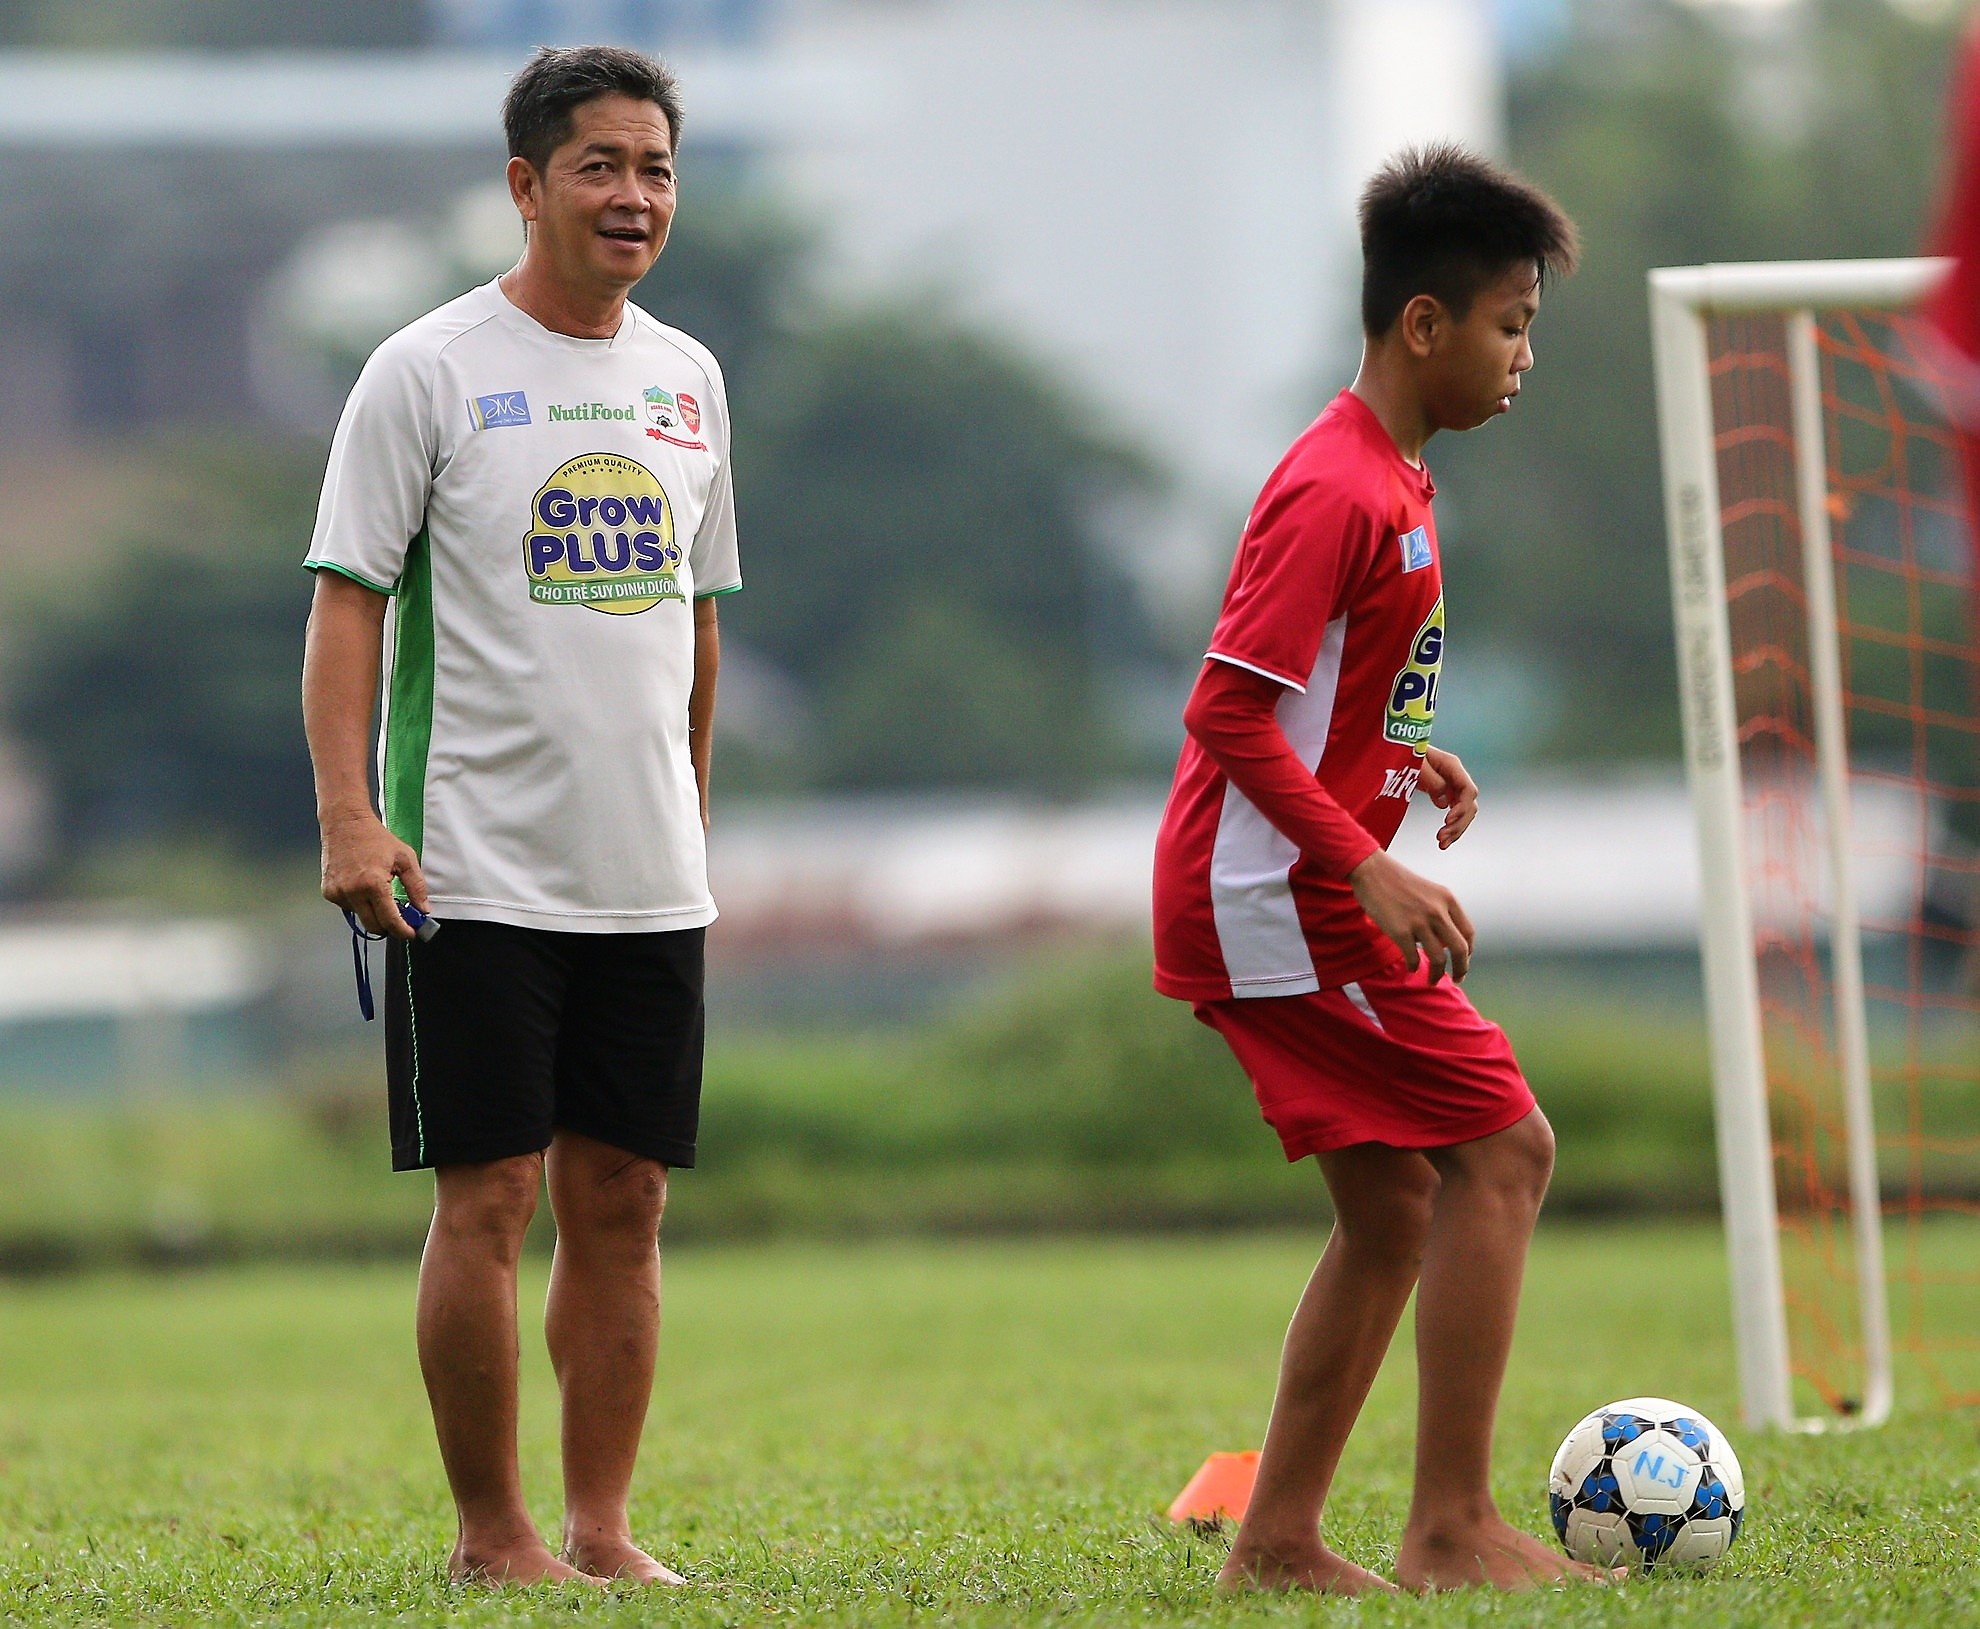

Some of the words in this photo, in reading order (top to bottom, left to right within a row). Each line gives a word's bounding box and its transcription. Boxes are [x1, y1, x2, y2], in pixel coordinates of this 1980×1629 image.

[547, 402, 637, 422] NutiFood
[562, 458, 601, 478] PREMIUM
[603, 458, 643, 476] QUALITY
[538, 488, 662, 528] Grow
[533, 585, 562, 600] CHO
[564, 582, 590, 600] TRẺ
[590, 584, 614, 599] SUY
[615, 581, 646, 597] DINH
